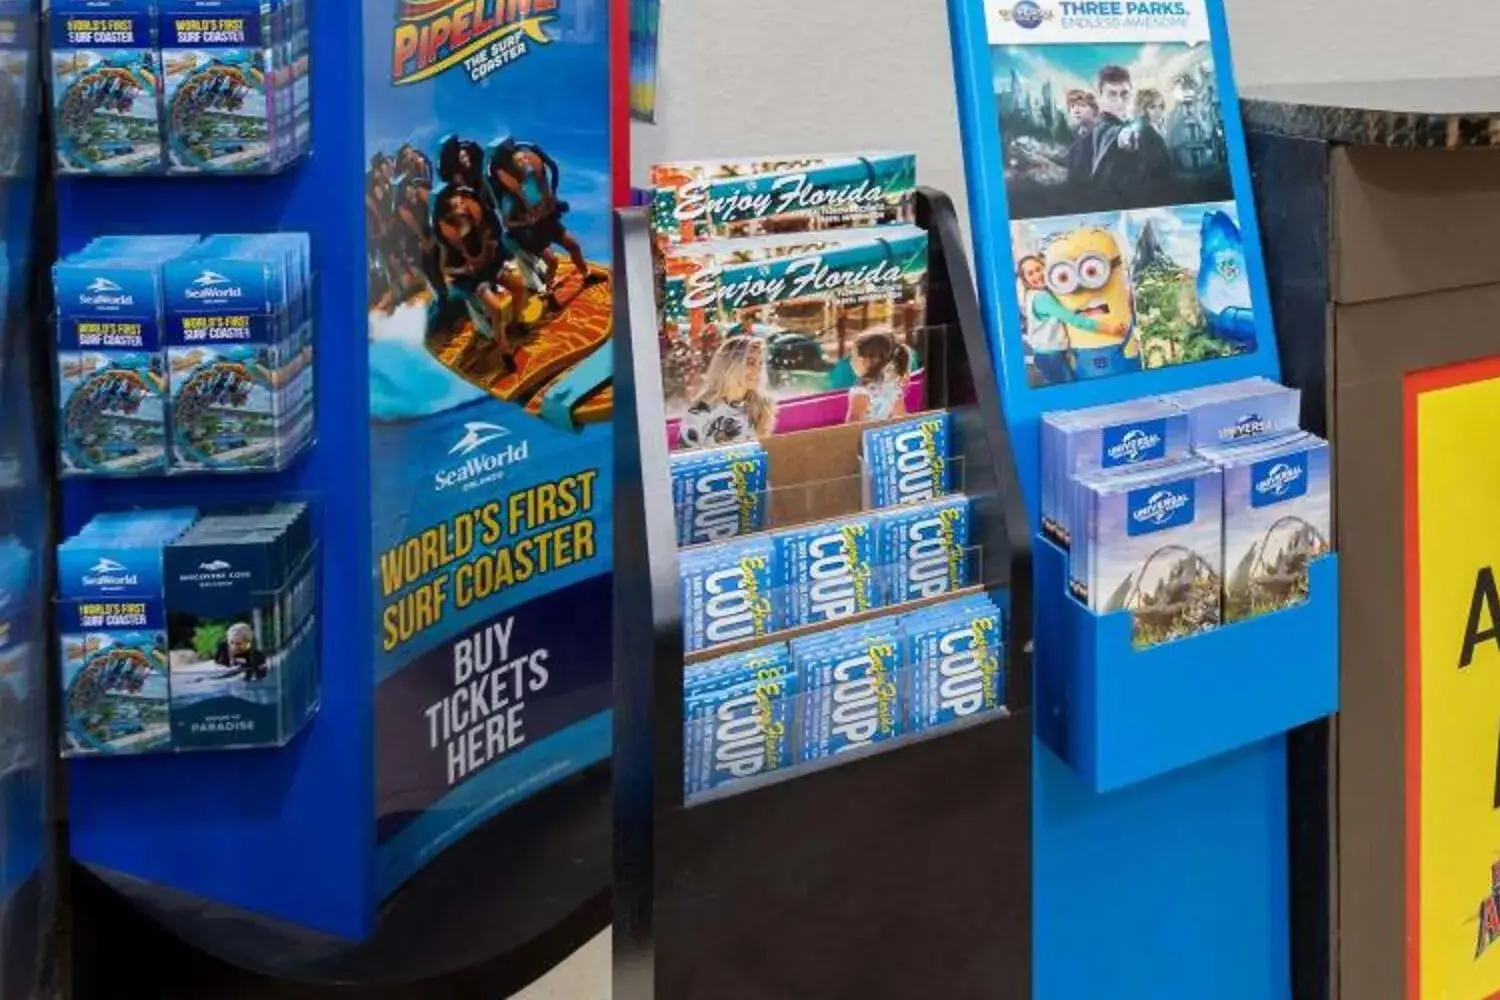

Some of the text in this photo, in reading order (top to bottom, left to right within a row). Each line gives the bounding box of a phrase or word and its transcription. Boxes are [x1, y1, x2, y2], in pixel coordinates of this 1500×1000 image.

[1059, 0, 1123, 16] THREE
[1126, 0, 1191, 16] PARKS.
[177, 31, 202, 44] SURF
[464, 33, 524, 72] THE SURF
[470, 45, 527, 83] COASTER
[673, 179, 773, 221] Enjoy
[772, 174, 884, 214] Florida
[79, 294, 134, 306] SeaWorld
[185, 287, 242, 299] SeaWorld
[682, 266, 786, 309] Enjoy
[785, 256, 903, 296] Florida
[79, 334, 101, 346] SURF
[183, 328, 207, 340] SURF
[1107, 433, 1161, 458] UNIVERSAL
[434, 440, 528, 491] SeaWorld
[462, 471, 505, 492] ORLANDO
[1255, 466, 1303, 492] UNIVERSAL
[695, 470, 740, 541] COUP
[1133, 493, 1189, 520] UNIVERSAL
[380, 503, 501, 597] WORLD'S
[508, 470, 597, 536] FIRST
[808, 532, 856, 622] COUP
[908, 518, 950, 600] COUP
[82, 573, 137, 586] SeaWorld
[383, 519, 596, 651] SURF COASTER
[105, 614, 147, 627] COASTER
[453, 616, 516, 686] BUY
[939, 628, 985, 716] COUP
[425, 649, 550, 749] TICKETS
[832, 655, 880, 750] COUP
[191, 719, 255, 733] PARADISE
[447, 702, 526, 785] HERE
[715, 695, 765, 777] COUP
